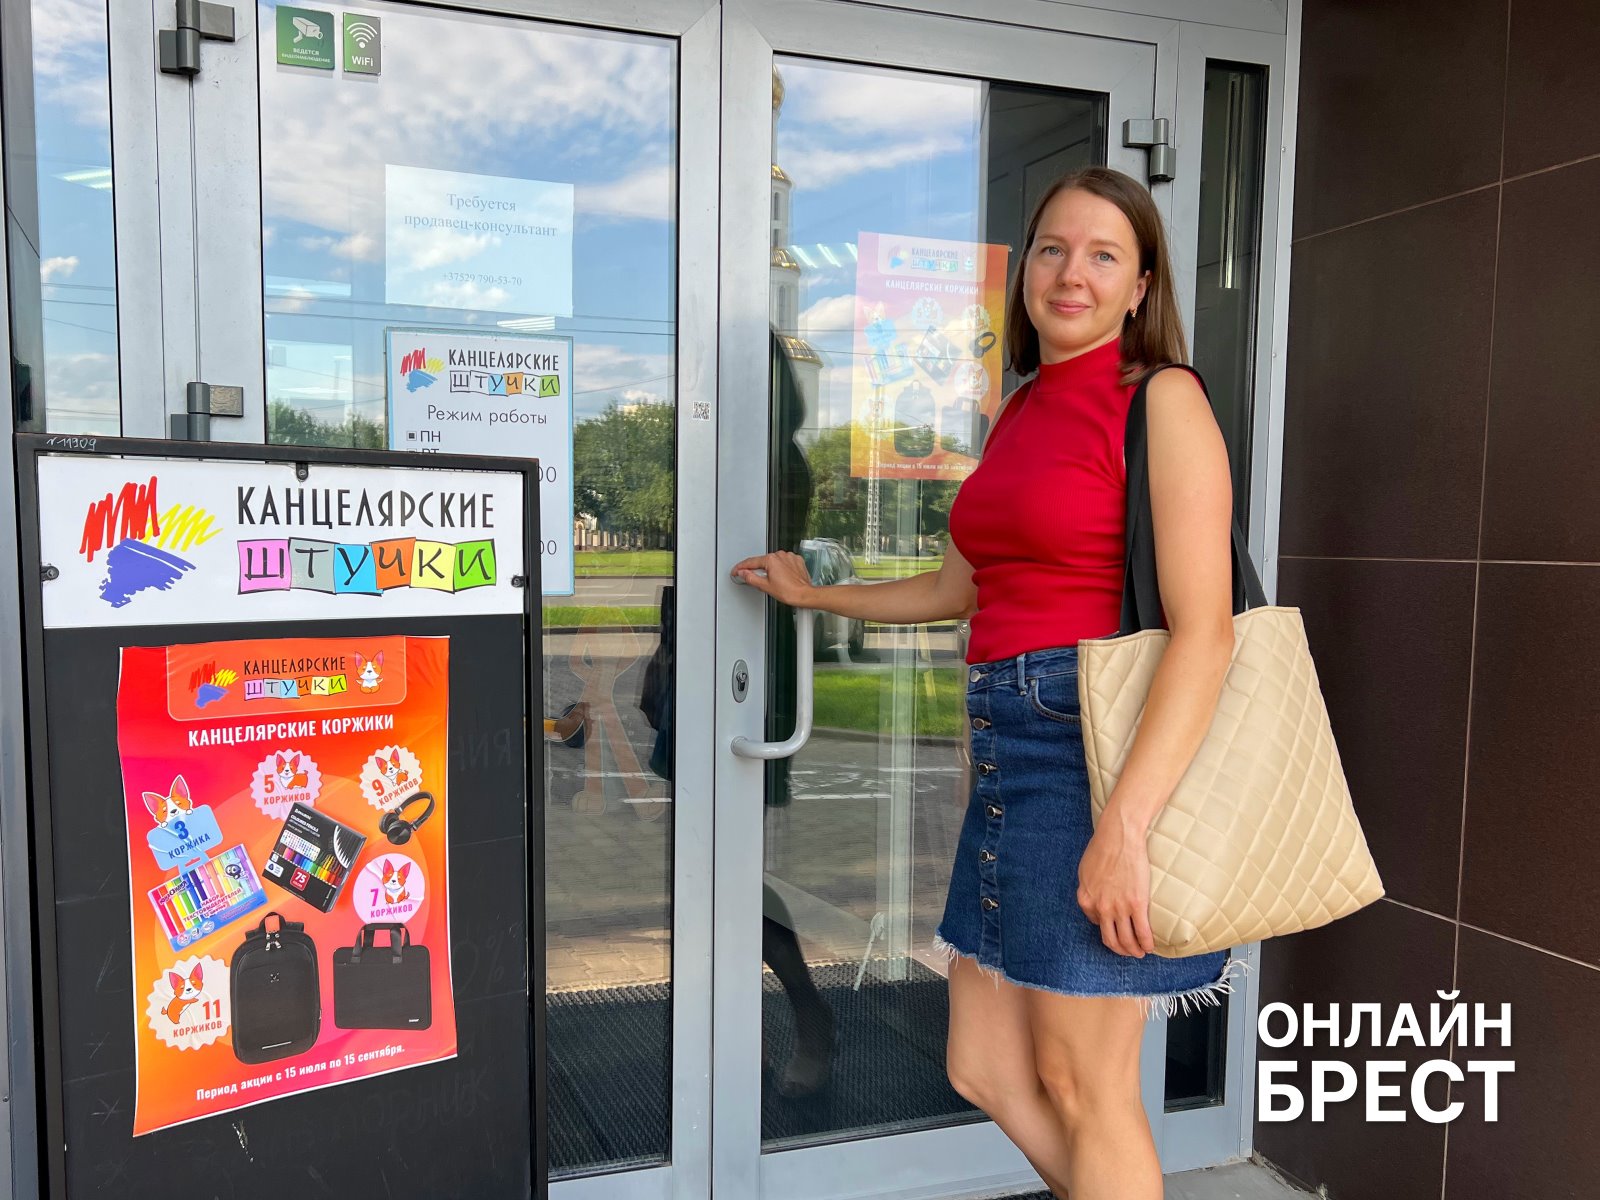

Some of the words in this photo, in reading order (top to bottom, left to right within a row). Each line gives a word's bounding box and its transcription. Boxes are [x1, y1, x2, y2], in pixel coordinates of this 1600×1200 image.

[352, 55, 374, 67] WiFi
[446, 193, 516, 212] Требуется
[404, 215, 559, 237] продавец-консультант
[443, 272, 476, 283] +37529
[478, 274, 522, 286] 790-53-70
[886, 279, 942, 293] КАНЦЕЛЯРСКИЕ
[944, 283, 979, 295] КОРЖИКИ
[449, 349, 560, 372] КАНЦЕЛЯРСКИЕ
[451, 372, 560, 396] ШТУЧКИ
[428, 404, 482, 422] Режим
[489, 409, 547, 426] работы
[420, 430, 441, 443] ПН
[236, 486, 496, 532] КАНЦЕЛЯРСКИЕ
[240, 541, 495, 592] ШТУЧКИ
[244, 656, 346, 676] КАНЦЕЛЯРСКИЕ
[245, 675, 346, 698] ШТУЧКИ
[188, 720, 317, 748] КАНЦЕЛЯРСКИЕ
[322, 714, 394, 736] КОРЖИКИ
[264, 774, 275, 794] 5
[372, 778, 385, 797] 9
[378, 778, 419, 806] КОРЖИКОВ
[264, 792, 310, 806] КОРЖИКОВ
[174, 820, 189, 840] 3
[168, 833, 210, 860] КОРЖИКА
[294, 872, 307, 884] 75
[201, 894, 220, 906] НАБОР
[370, 888, 379, 907] 7
[370, 902, 413, 918] КОРЖИКОВ
[202, 998, 221, 1020] 11
[172, 1020, 222, 1038] КОРЖИКОВ
[196, 1083, 238, 1101] Период
[240, 1074, 273, 1090] акции
[276, 1072, 282, 1081] с
[284, 1066, 296, 1078] 15
[299, 1061, 327, 1076] июля
[329, 1058, 342, 1069] по
[344, 1054, 356, 1066] 15
[358, 1044, 406, 1063] сентября.
